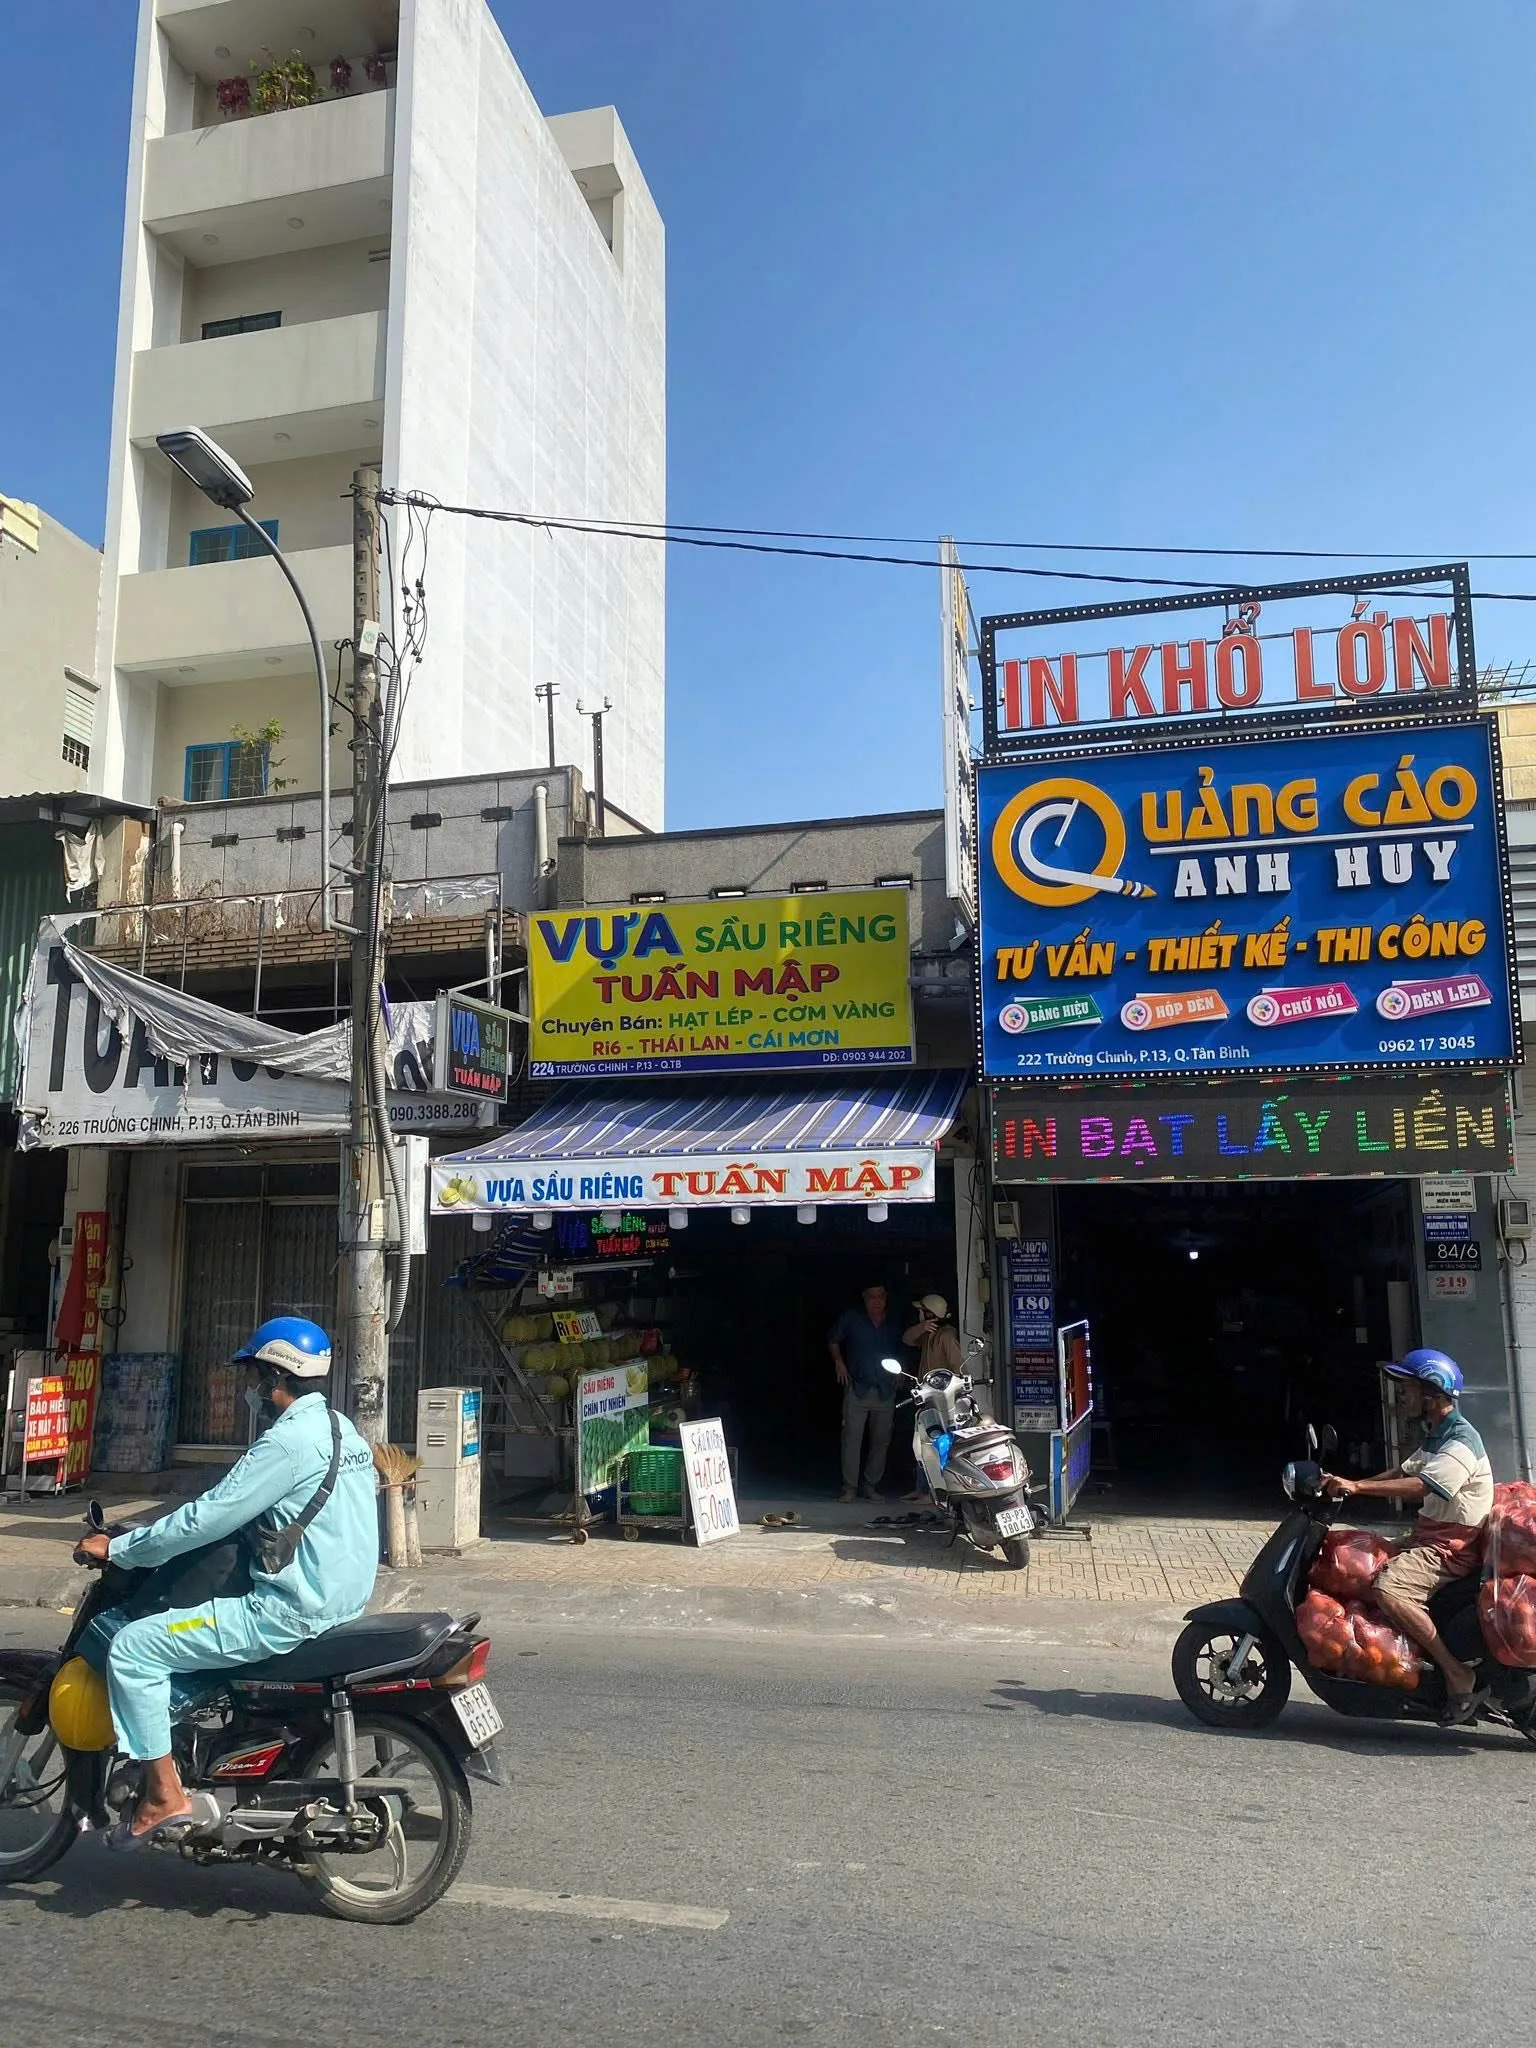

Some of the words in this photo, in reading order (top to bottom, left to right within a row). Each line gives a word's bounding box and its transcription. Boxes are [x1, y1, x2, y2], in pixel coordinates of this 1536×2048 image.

[1004, 652, 1079, 730] IN
[1108, 602, 1263, 719] KHỔ
[1293, 601, 1451, 701] LỚN
[1343, 754, 1477, 827] CÁO
[1174, 852, 1292, 898] ANH
[1334, 840, 1457, 889] HUY
[537, 912, 684, 971] VỰA
[695, 916, 767, 953] SẦU
[779, 911, 896, 950] RIÊNG
[996, 939, 1040, 980] TƯ
[1046, 926, 1116, 977] VẤN
[1148, 919, 1239, 972] THIẾT
[1243, 915, 1290, 967] KẾ
[1317, 926, 1373, 963] THI
[1378, 913, 1487, 959] CÔNG
[592, 963, 719, 1004] TUẤN
[734, 959, 840, 1002] MẬP
[1281, 997, 1313, 1017] CHỮ
[1412, 988, 1445, 1010] ĐÈN
[1449, 982, 1481, 1002] LED
[542, 1018, 614, 1036] Chuyên
[619, 1016, 663, 1031] Bán:
[669, 1011, 709, 1031] HẠT
[716, 1007, 753, 1026] LÉP
[773, 1005, 826, 1023] CƠM
[832, 1000, 895, 1020] VÀNG
[1063, 1001, 1089, 1021] HIỆU
[452, 1008, 480, 1065] VỰA
[592, 1041, 622, 1056] Ri6
[639, 1034, 684, 1054] THÁI
[690, 1035, 729, 1052] LAN
[748, 1029, 783, 1049] CÁI
[788, 1029, 839, 1047] MƠN
[1378, 1039, 1415, 1053] 0962
[1419, 1038, 1435, 1052] 17
[1439, 1036, 1476, 1050] 3045
[532, 1062, 555, 1076] 224
[597, 1063, 628, 1073] CHINH
[636, 1061, 653, 1071] P.13
[660, 1060, 682, 1070] Q.TB
[843, 1052, 866, 1062] 0903
[869, 1051, 886, 1061] 944
[888, 1050, 906, 1060] 202
[1017, 1054, 1042, 1066] 222
[1045, 1051, 1093, 1067] Trường
[1219, 1044, 1250, 1059] Bình
[59, 1121, 79, 1136] 226
[140, 1115, 184, 1134] CHINH,
[267, 1108, 300, 1127] BÌNH
[390, 1103, 478, 1121] 090.3388.280
[1005, 1117, 1056, 1158] IN
[1081, 1114, 1195, 1166] BẠT
[1217, 1095, 1331, 1156] LẤY
[1356, 1088, 1496, 1152] LIỀN
[486, 1177, 525, 1206] VỰA
[532, 1170, 571, 1201] SẦU
[580, 1172, 643, 1200] RIÊNG
[652, 1162, 789, 1196] TUẤN
[806, 1160, 923, 1197] MẬP
[1438, 1244, 1478, 1260] 84/6
[1436, 1277, 1467, 1288] 219
[1016, 1296, 1050, 1311] 180
[28, 1420, 37, 1438] XE
[1001, 1509, 1025, 1522] 59-P3
[459, 1687, 487, 1717] 66-F8
[470, 1709, 498, 1741] 9515
